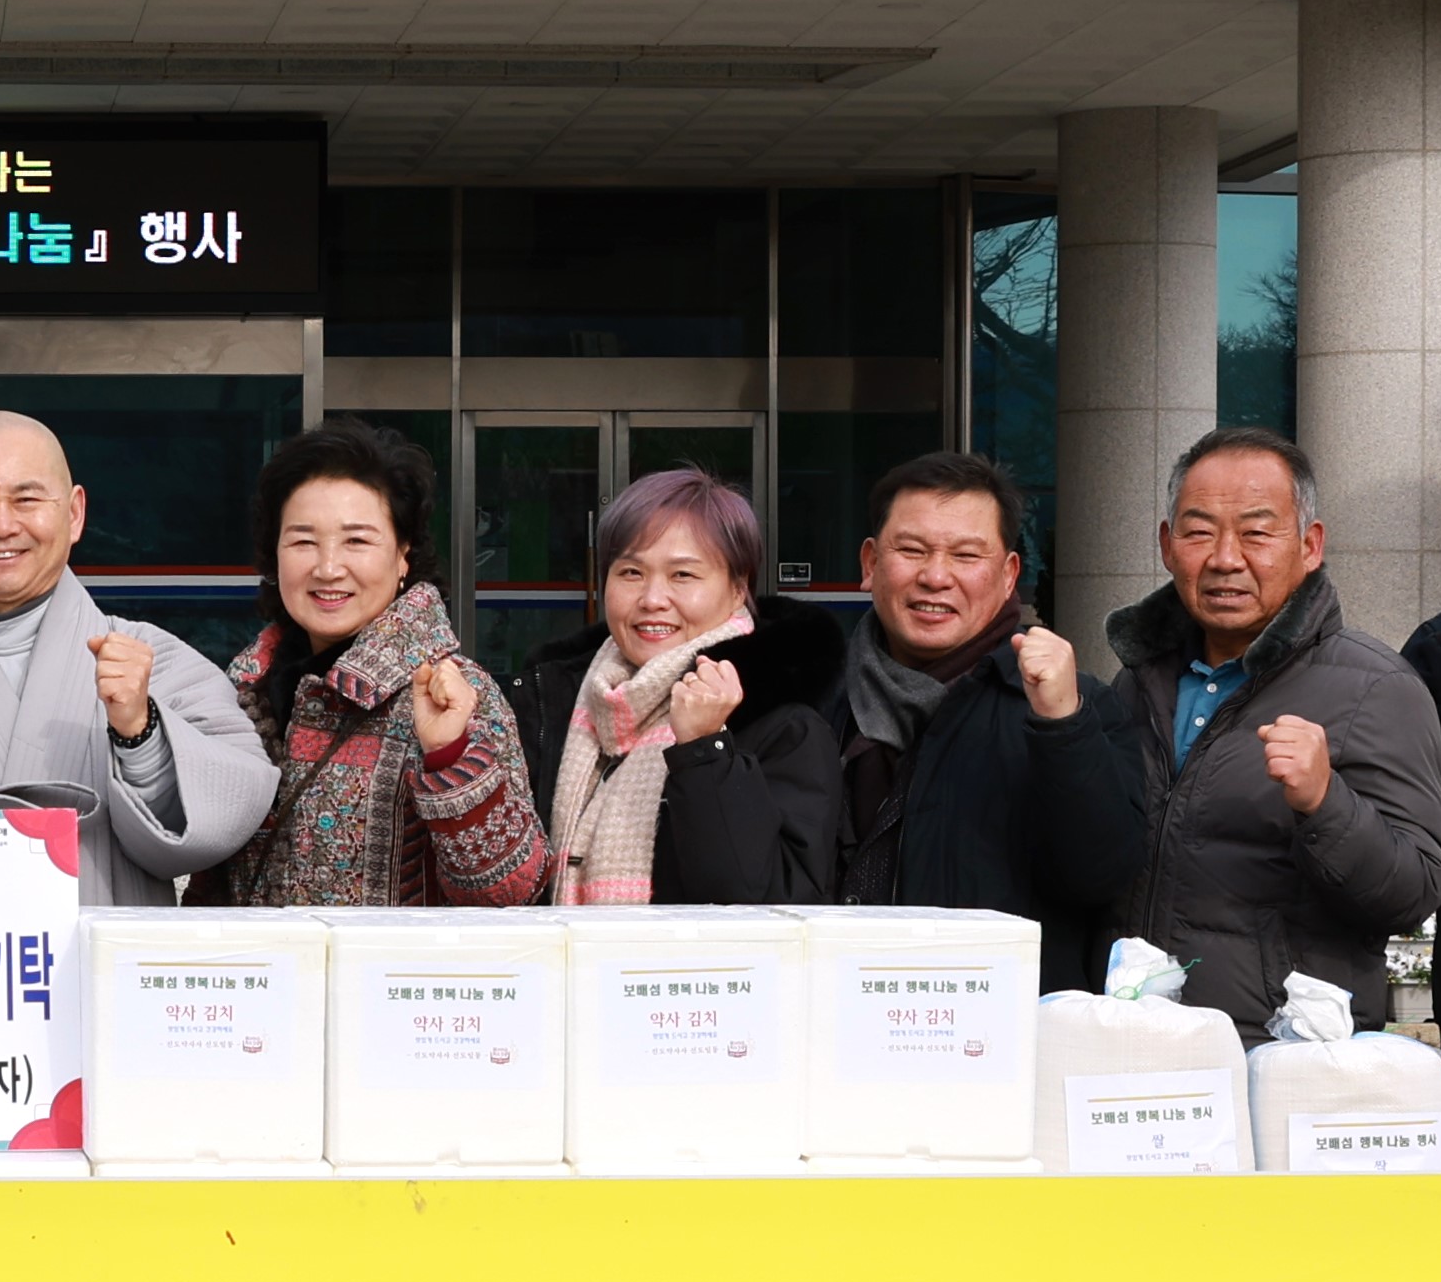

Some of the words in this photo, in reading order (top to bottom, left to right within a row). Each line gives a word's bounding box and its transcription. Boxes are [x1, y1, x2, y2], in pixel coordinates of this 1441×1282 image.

[141, 212, 242, 263] 행사
[165, 1004, 196, 1022] 약사
[204, 1004, 233, 1022] 김치
[650, 1011, 680, 1029] 약사
[688, 1010, 717, 1028] 김치
[887, 1008, 918, 1026] 약사
[925, 1008, 954, 1025] 김치
[413, 1015, 444, 1033] 약사
[452, 1016, 481, 1033] 김치
[1136, 1109, 1160, 1123] 행복
[1163, 1108, 1186, 1121] 나눔
[1192, 1106, 1213, 1120] 행사
[1359, 1135, 1384, 1149] 행복
[1387, 1135, 1410, 1148] 나눔
[1417, 1133, 1437, 1147] 행사
